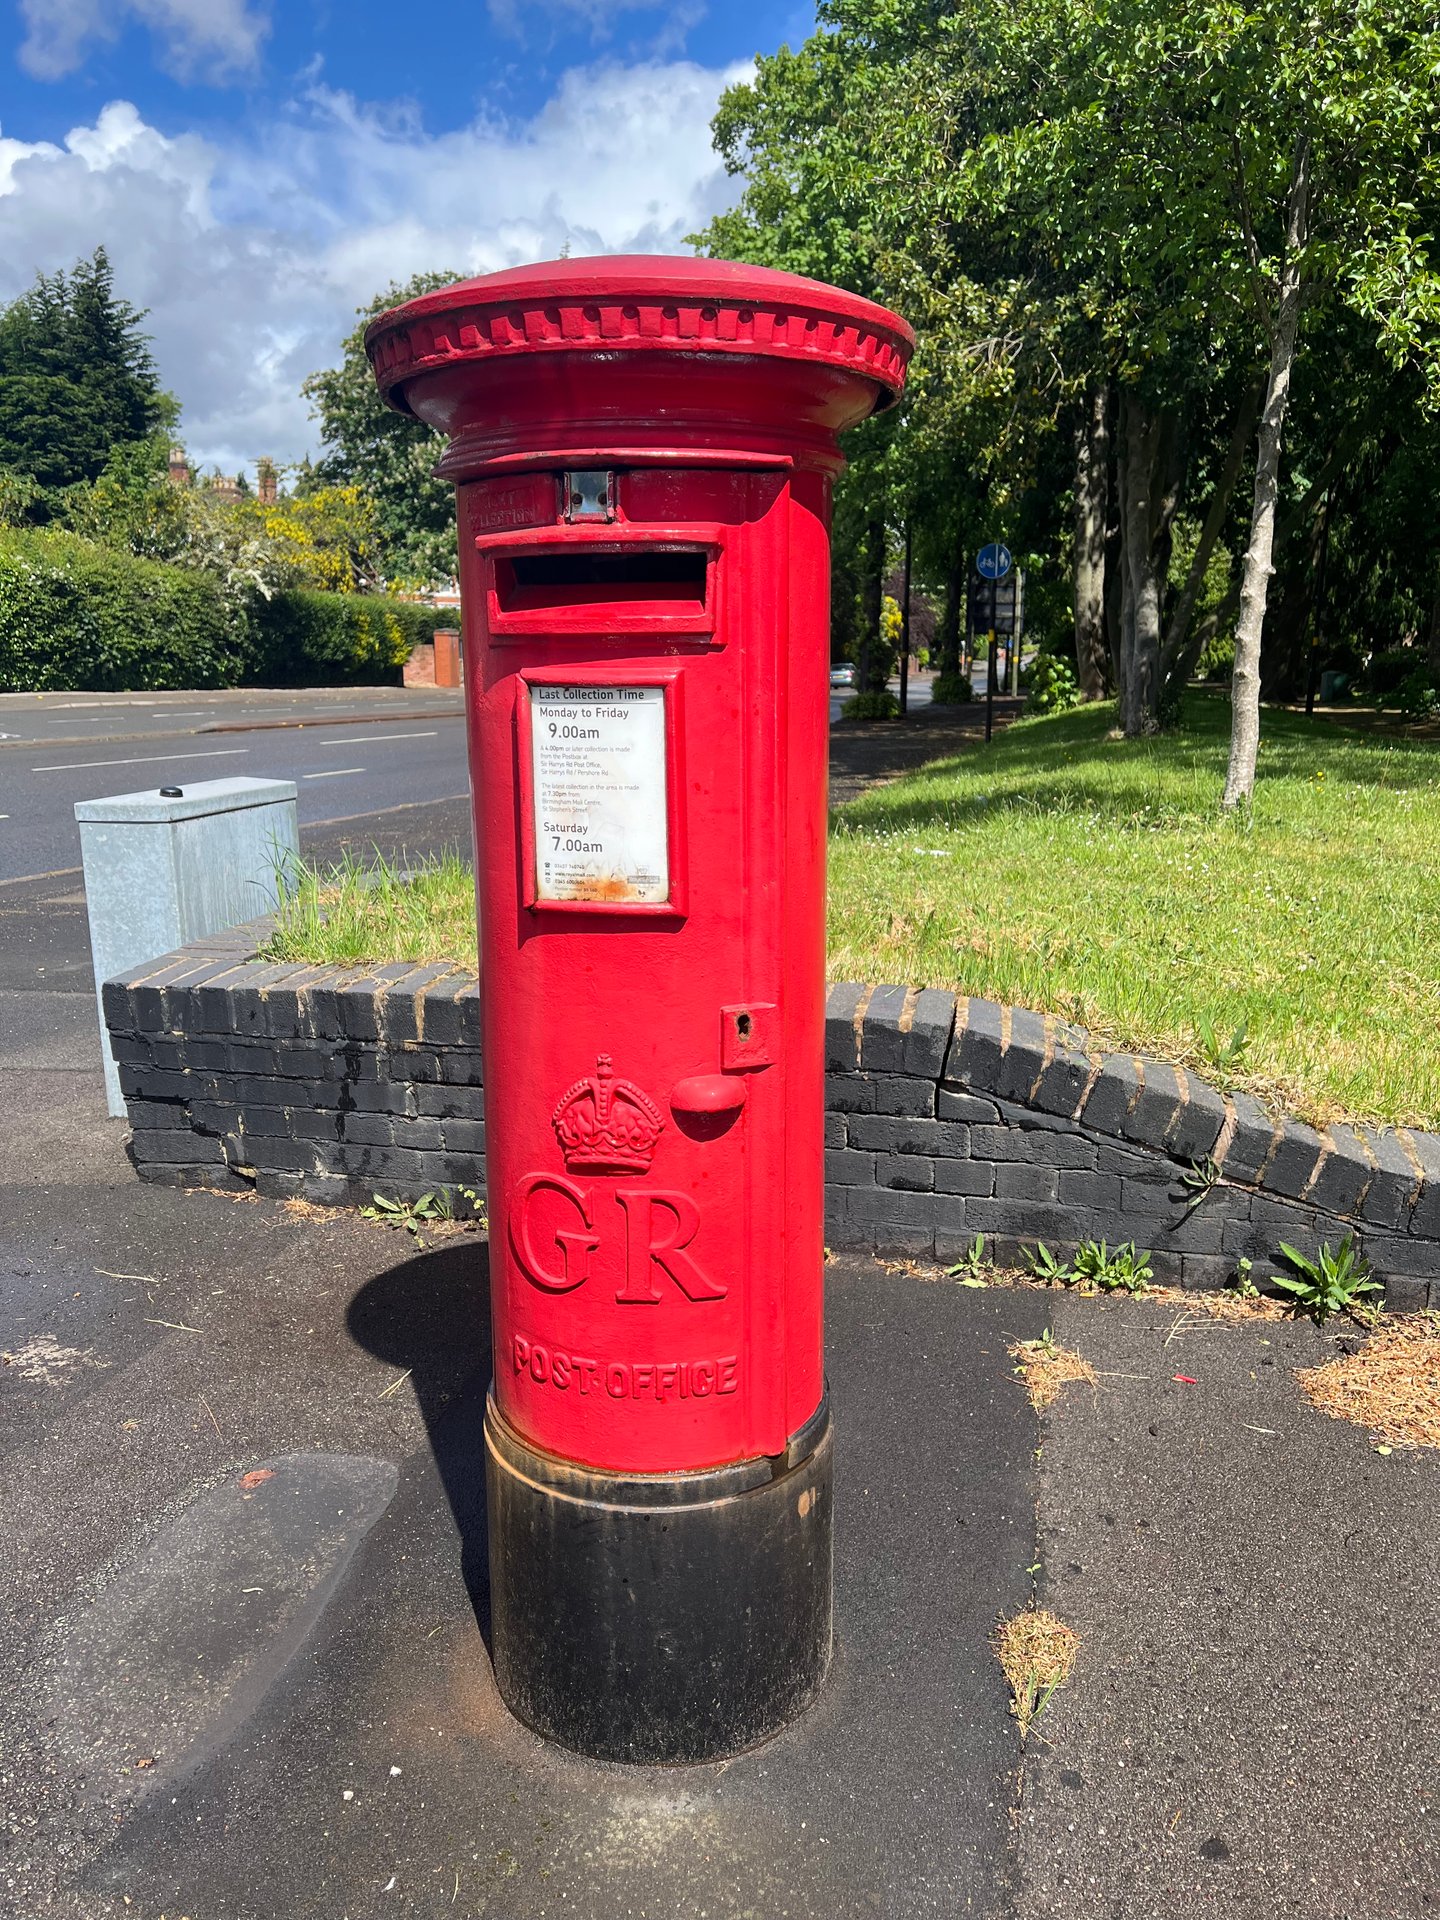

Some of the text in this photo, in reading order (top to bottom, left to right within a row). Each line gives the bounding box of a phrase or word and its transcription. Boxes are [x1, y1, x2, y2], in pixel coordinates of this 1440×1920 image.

[539, 689, 645, 700] Last Collection Time
[540, 707, 629, 720] Monday to Friday
[548, 722, 600, 738] 9.00am
[544, 822, 588, 835] Saturday
[552, 836, 603, 852] 7.00am
[513, 1334, 740, 1400] POST OFFICE
